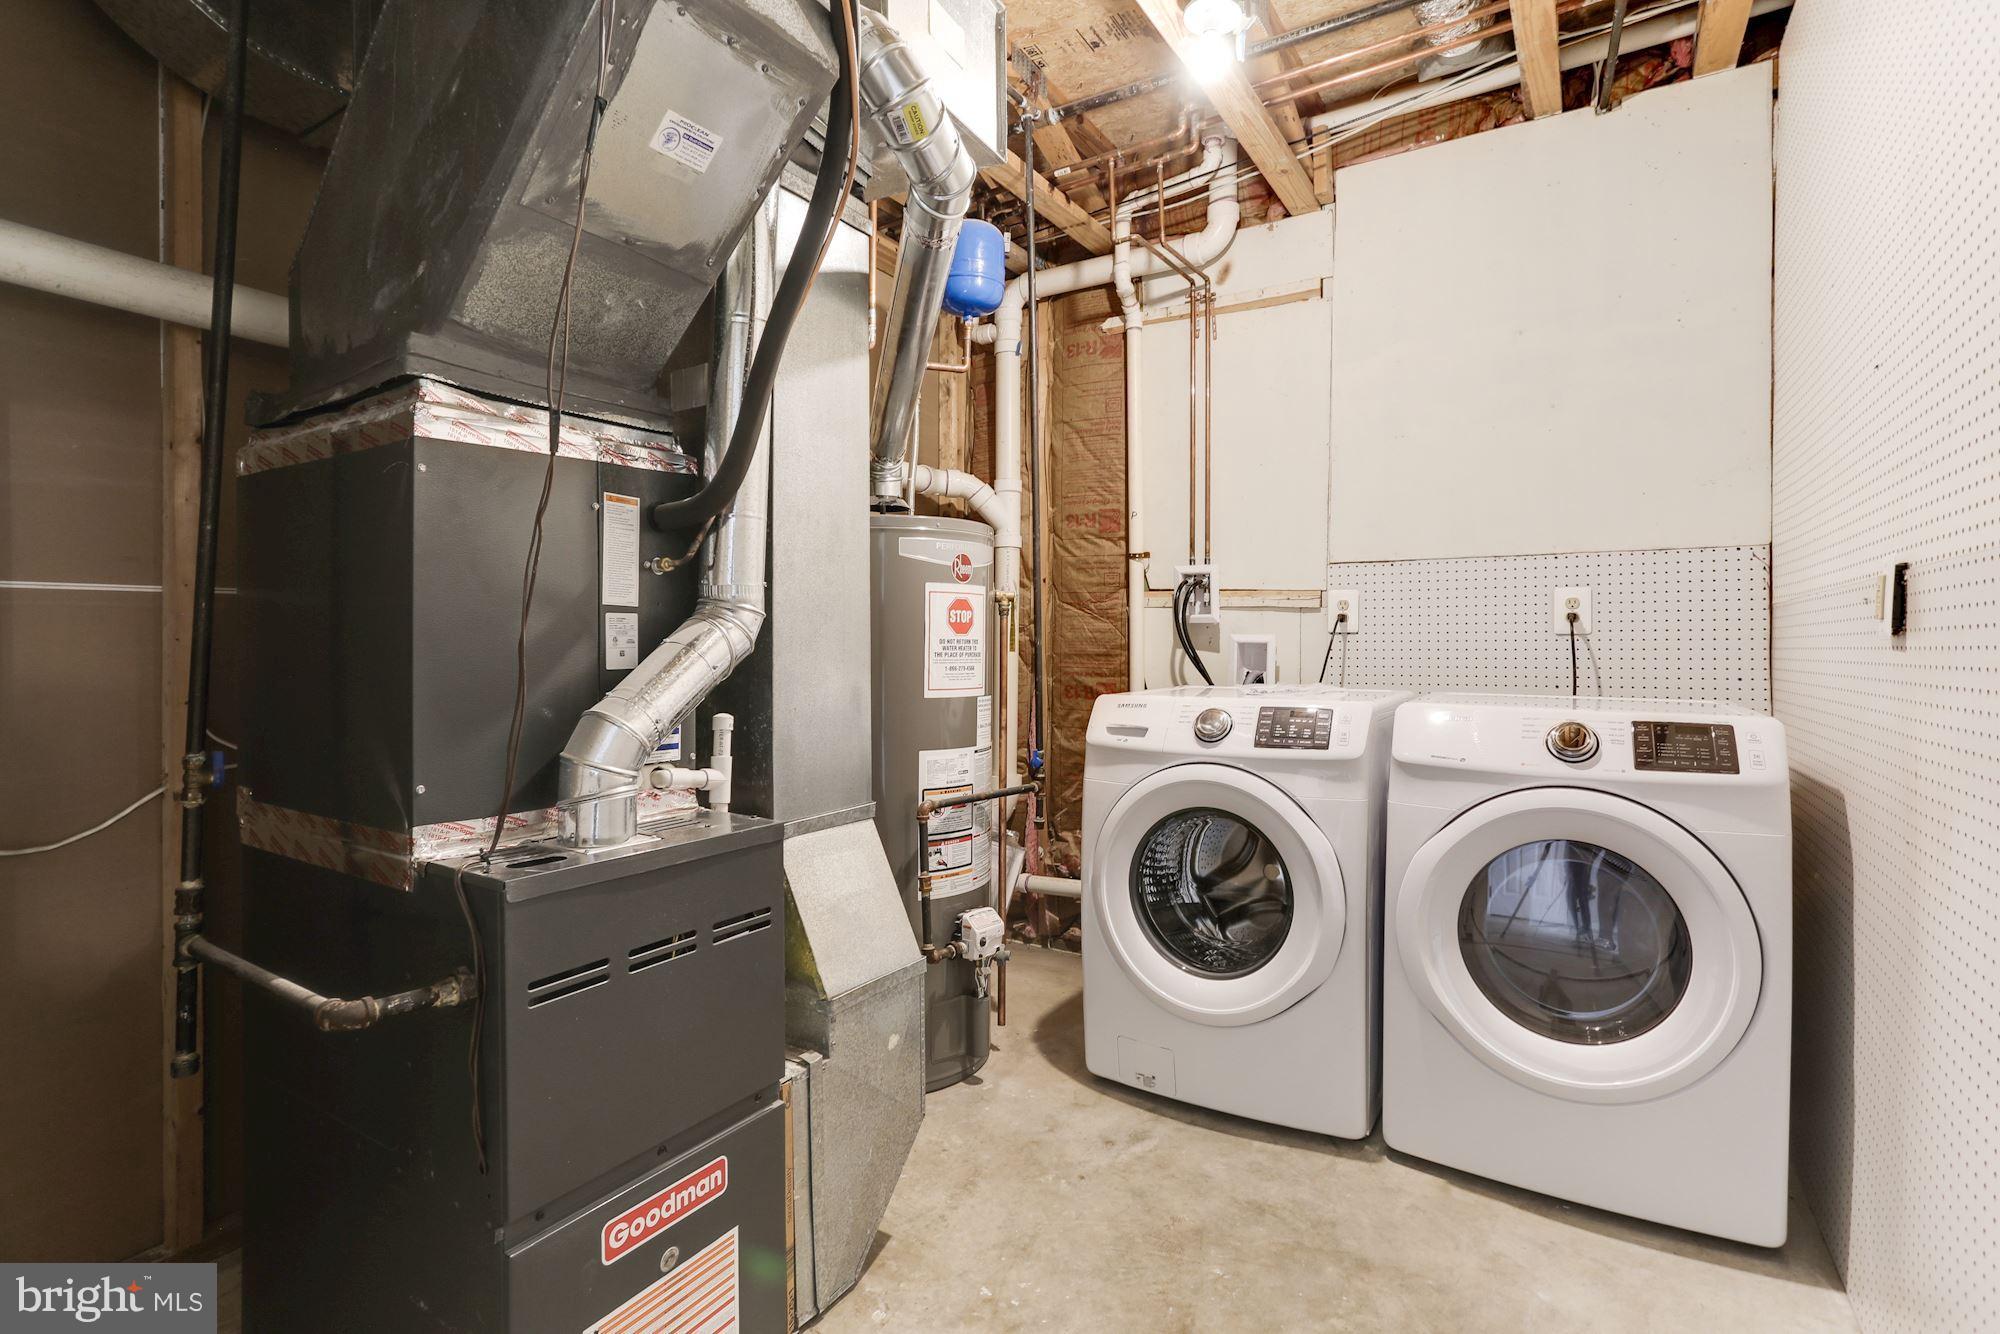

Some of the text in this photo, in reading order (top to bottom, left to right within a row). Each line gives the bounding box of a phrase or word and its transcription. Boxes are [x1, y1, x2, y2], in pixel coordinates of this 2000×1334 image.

[1065, 513, 1098, 529] R-13
[949, 609, 972, 623] STOP
[609, 1169, 722, 1249] Goodman
